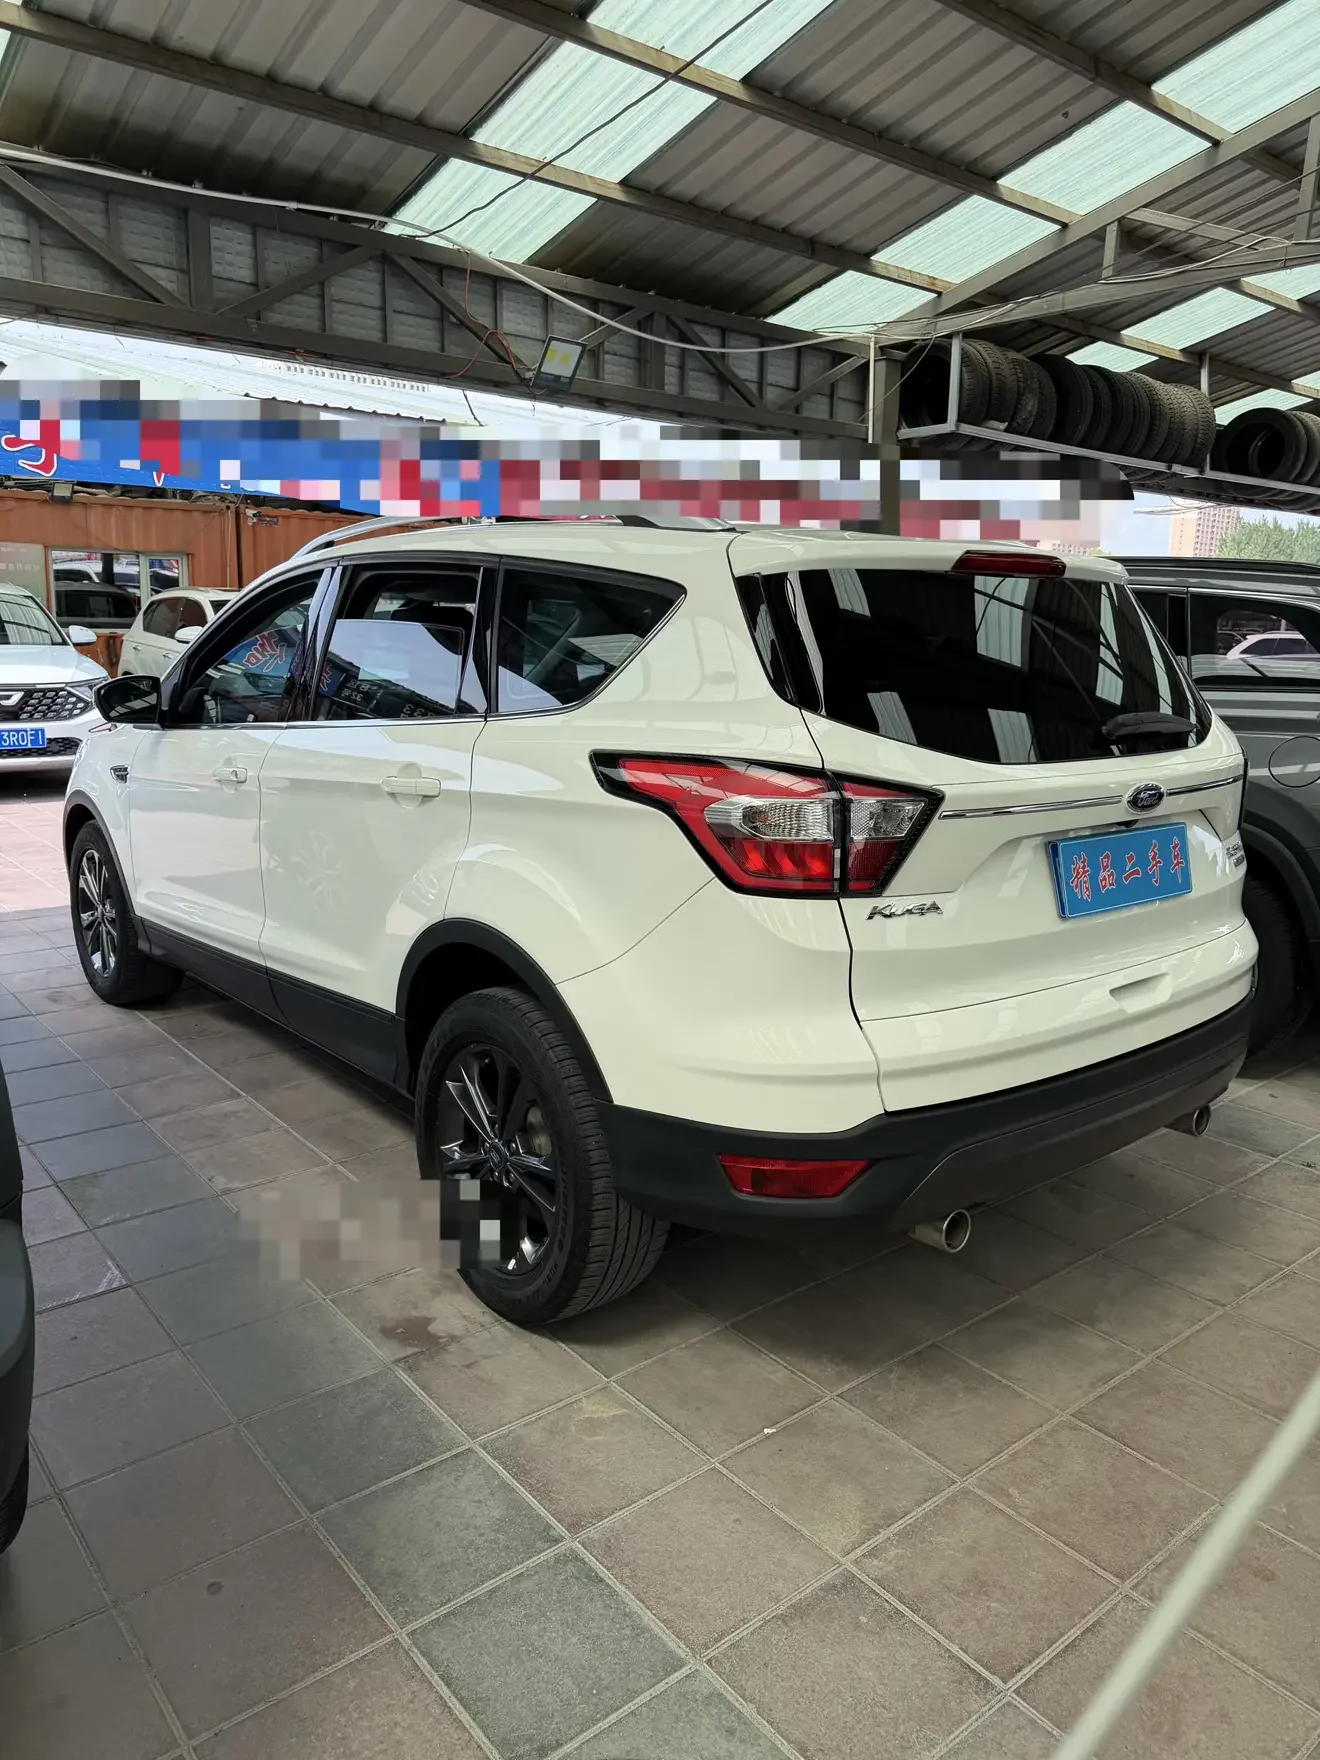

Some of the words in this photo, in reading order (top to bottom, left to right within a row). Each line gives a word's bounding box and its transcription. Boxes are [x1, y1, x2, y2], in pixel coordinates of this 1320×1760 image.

[1135, 788, 1160, 802] Ford
[1070, 836, 1185, 902] 精品二手车
